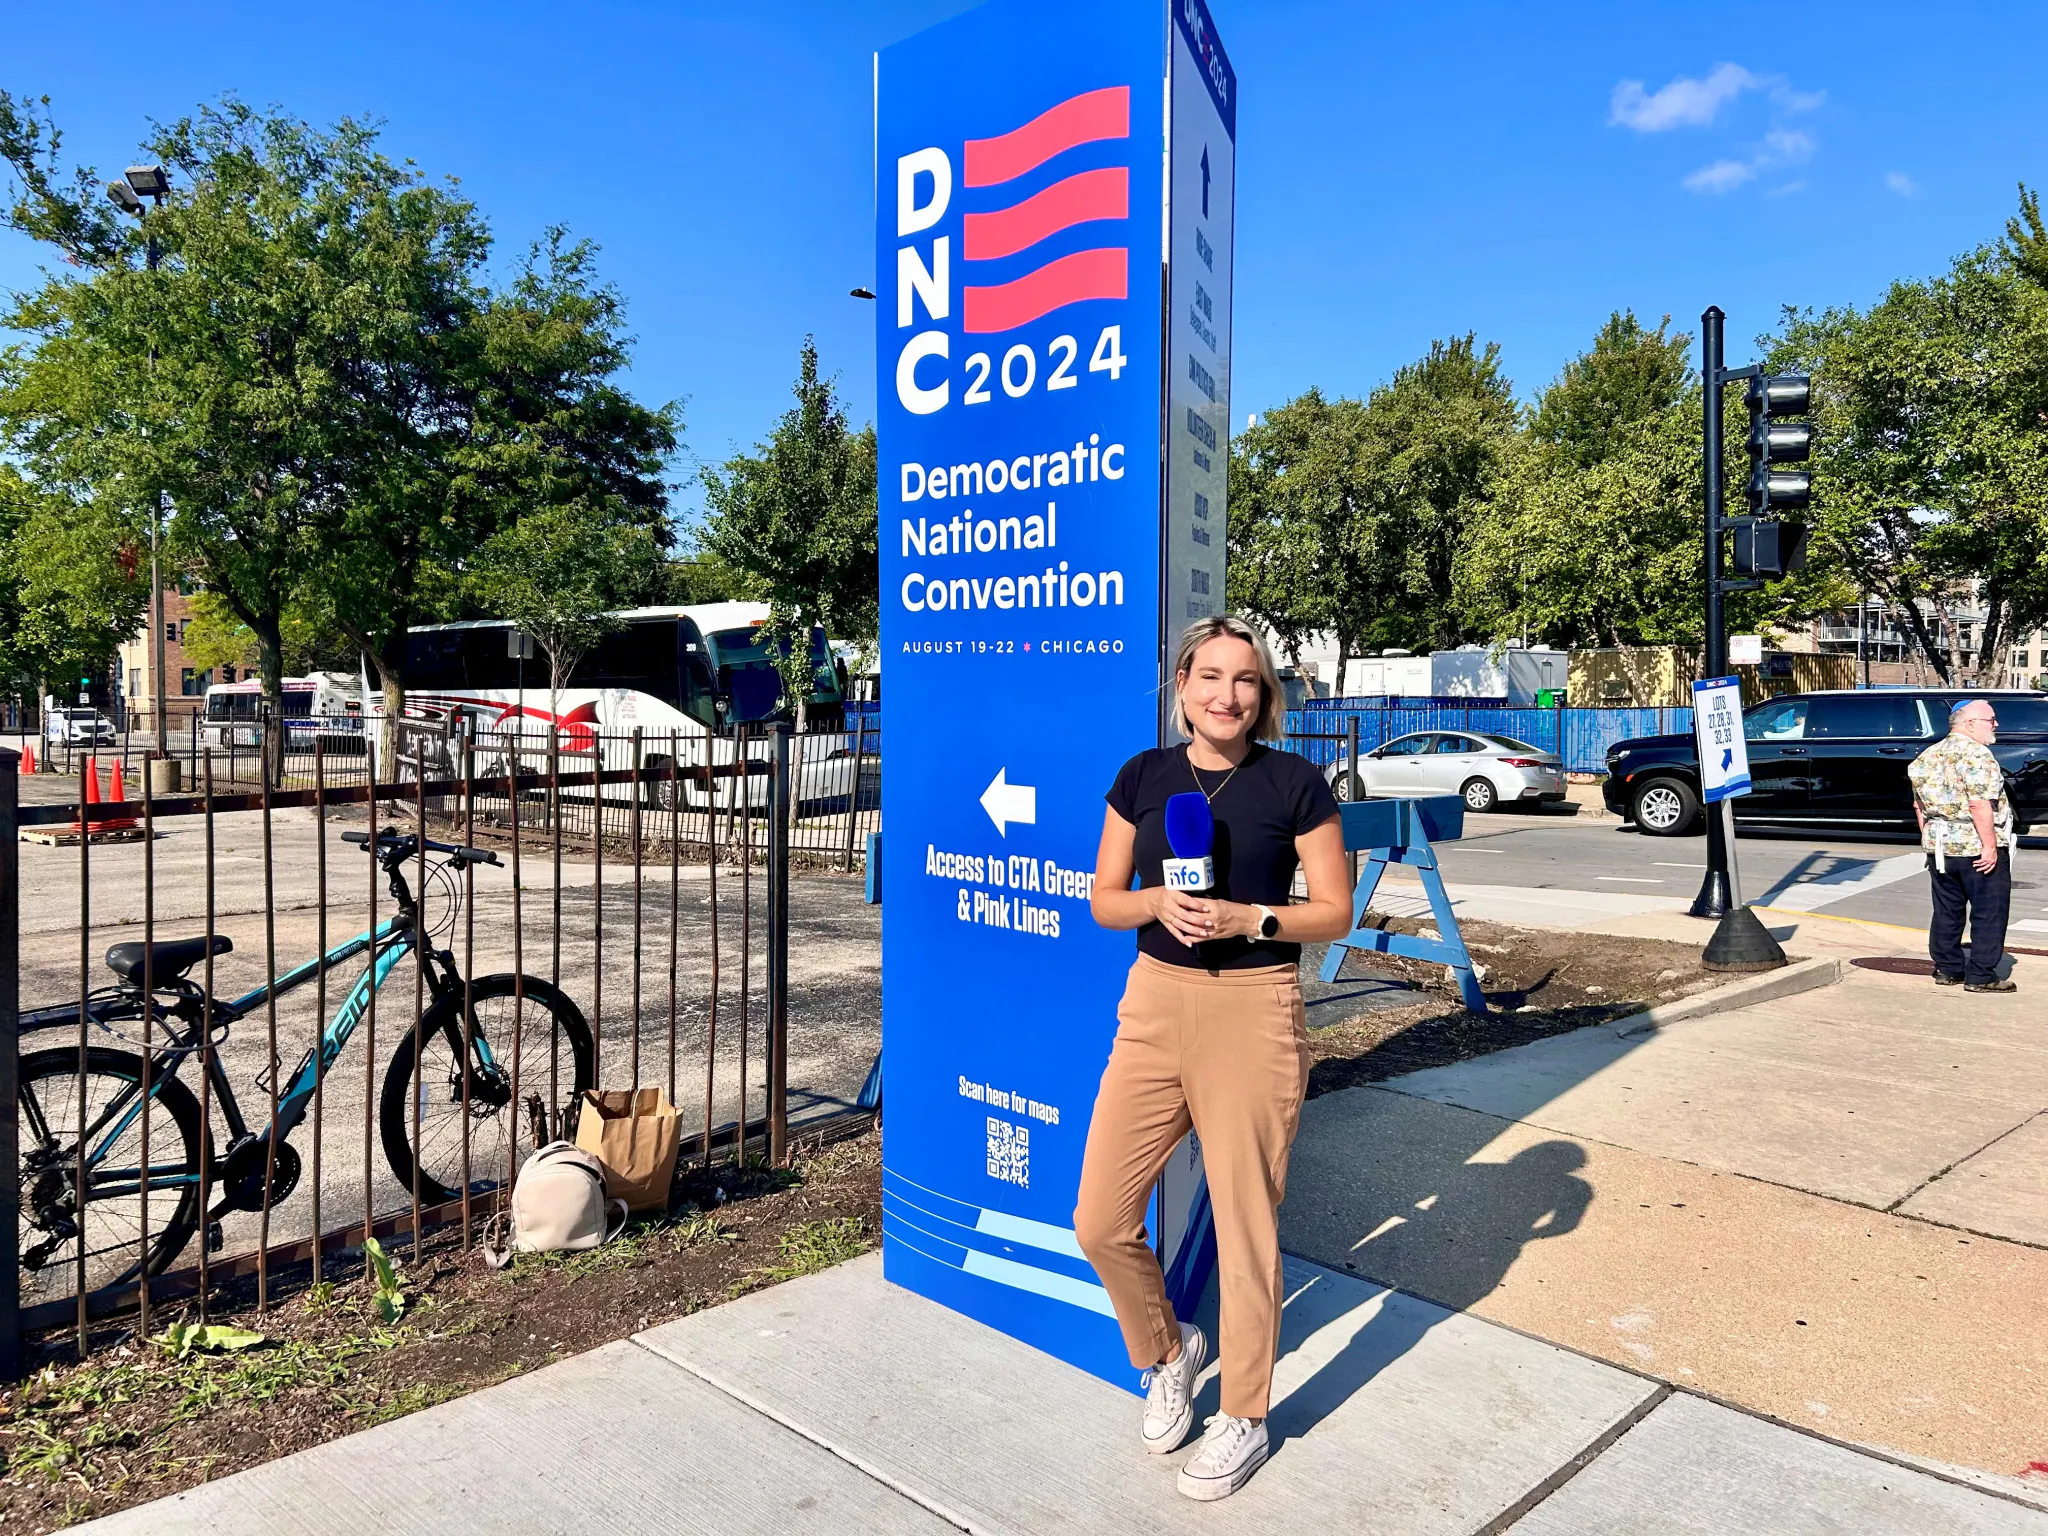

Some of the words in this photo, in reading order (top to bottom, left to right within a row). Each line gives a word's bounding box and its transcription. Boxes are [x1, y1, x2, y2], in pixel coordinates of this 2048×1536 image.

[1209, 44, 1227, 107] 2024
[963, 324, 1128, 406] 2024
[901, 432, 1125, 503] Democratic
[901, 501, 1056, 557] National
[901, 560, 1124, 612] Convention
[902, 641, 963, 654] AUGUST
[970, 640, 1015, 654] 19-22
[1040, 640, 1124, 654] CHICAGO
[1712, 695, 1727, 711] LOTS
[926, 843, 985, 884] Access
[987, 854, 1005, 887] to
[1008, 855, 1041, 892] CTA
[1044, 859, 1096, 901] Green
[1169, 865, 1200, 886] info
[957, 888, 971, 922] &
[974, 890, 1010, 929] Pink
[1013, 897, 1060, 939] Lines
[958, 1075, 985, 1102] Scan
[985, 1082, 1010, 1110] here
[1011, 1090, 1027, 1115] for
[1028, 1099, 1060, 1126] maps
